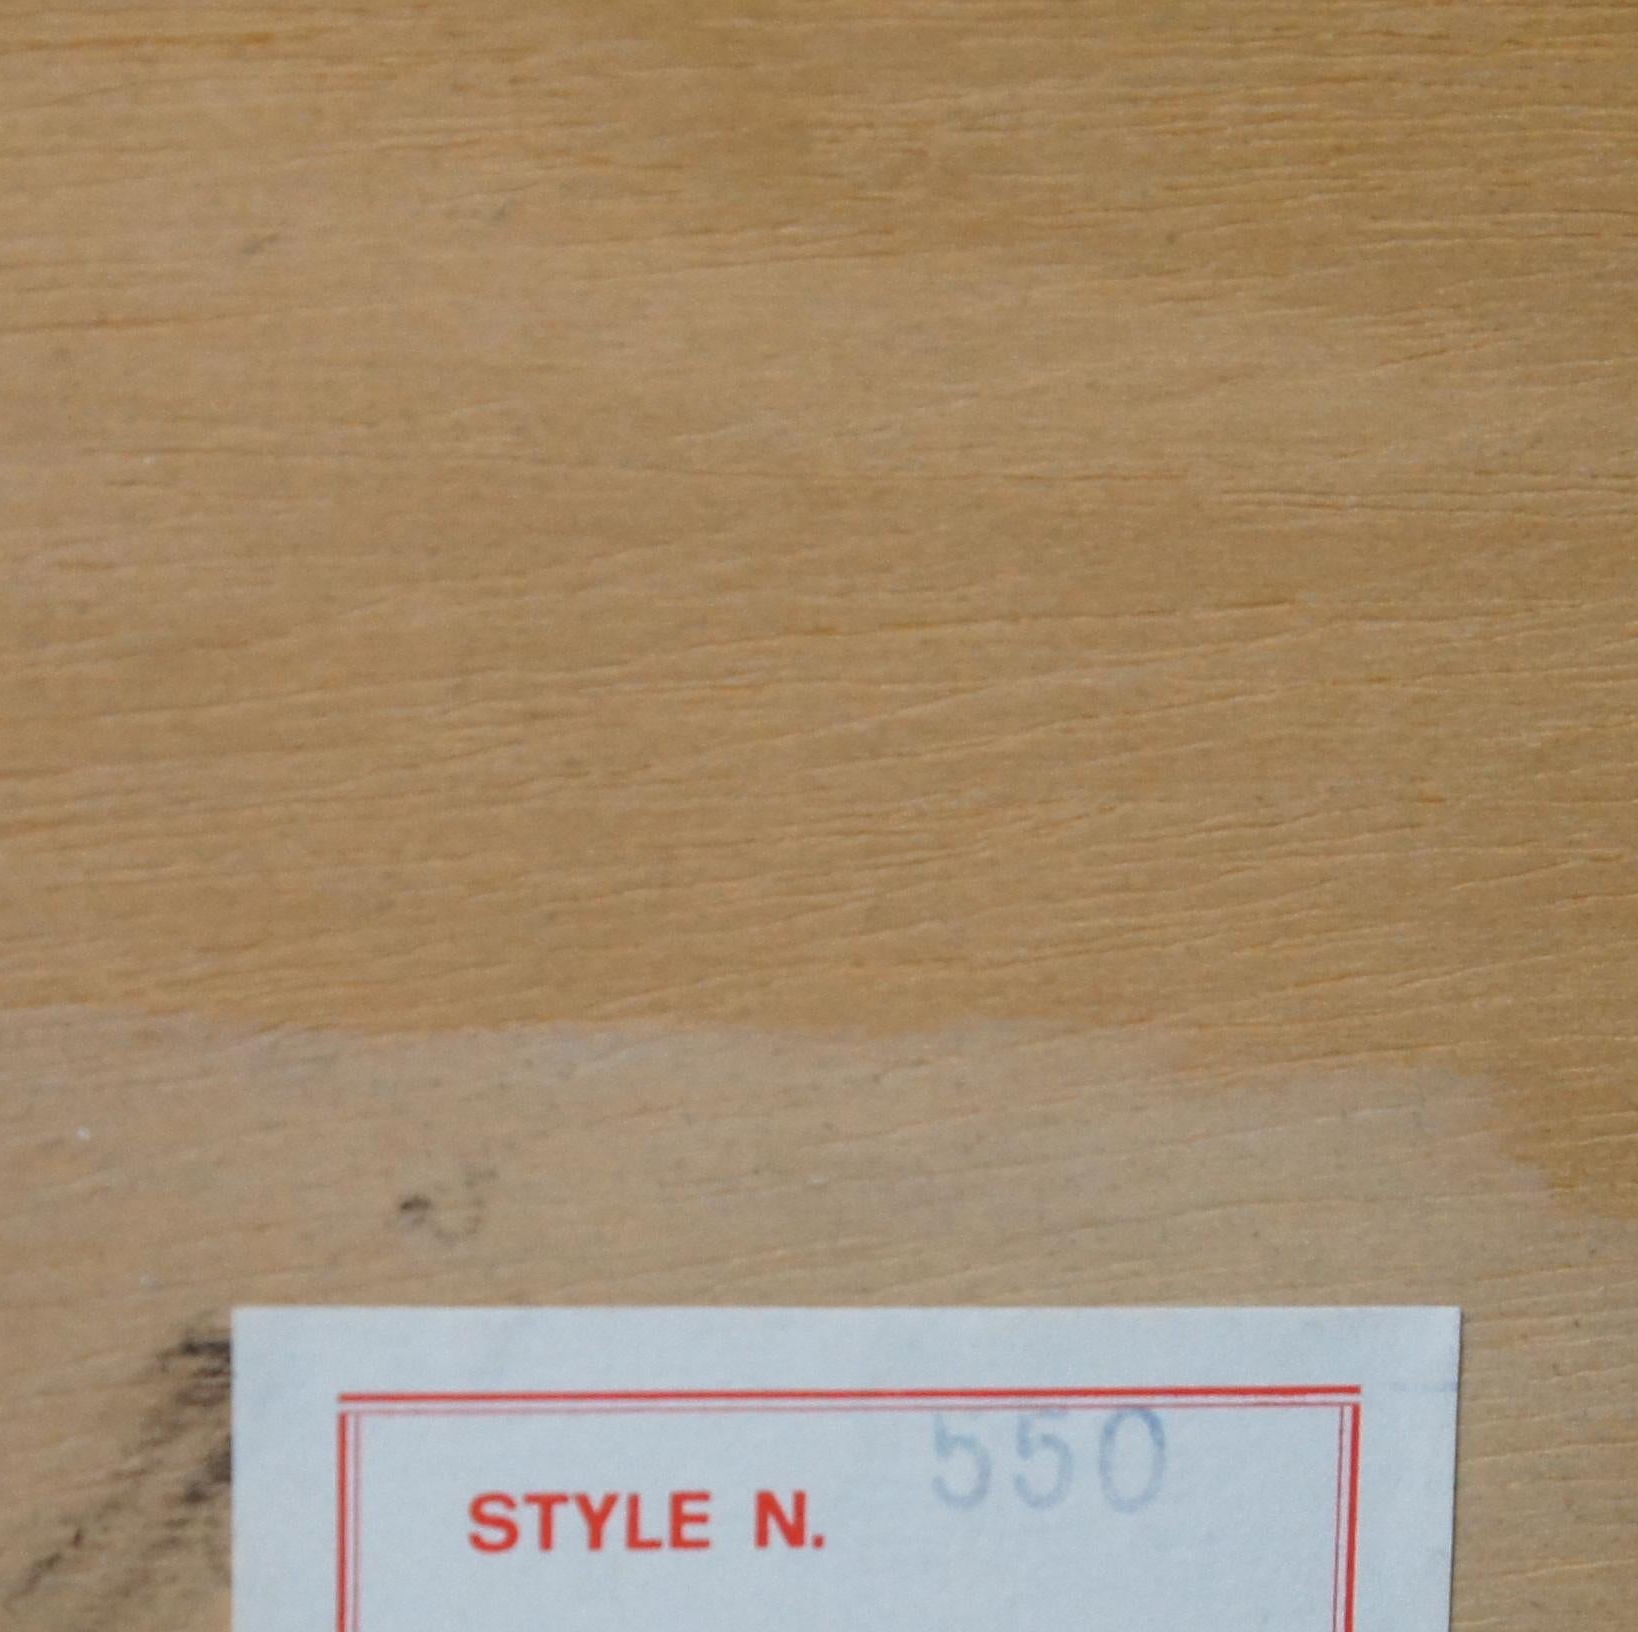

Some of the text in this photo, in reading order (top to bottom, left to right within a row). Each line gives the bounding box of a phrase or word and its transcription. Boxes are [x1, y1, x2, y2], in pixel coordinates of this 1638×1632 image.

[467, 1404, 1168, 1554] STYLE N. 550
